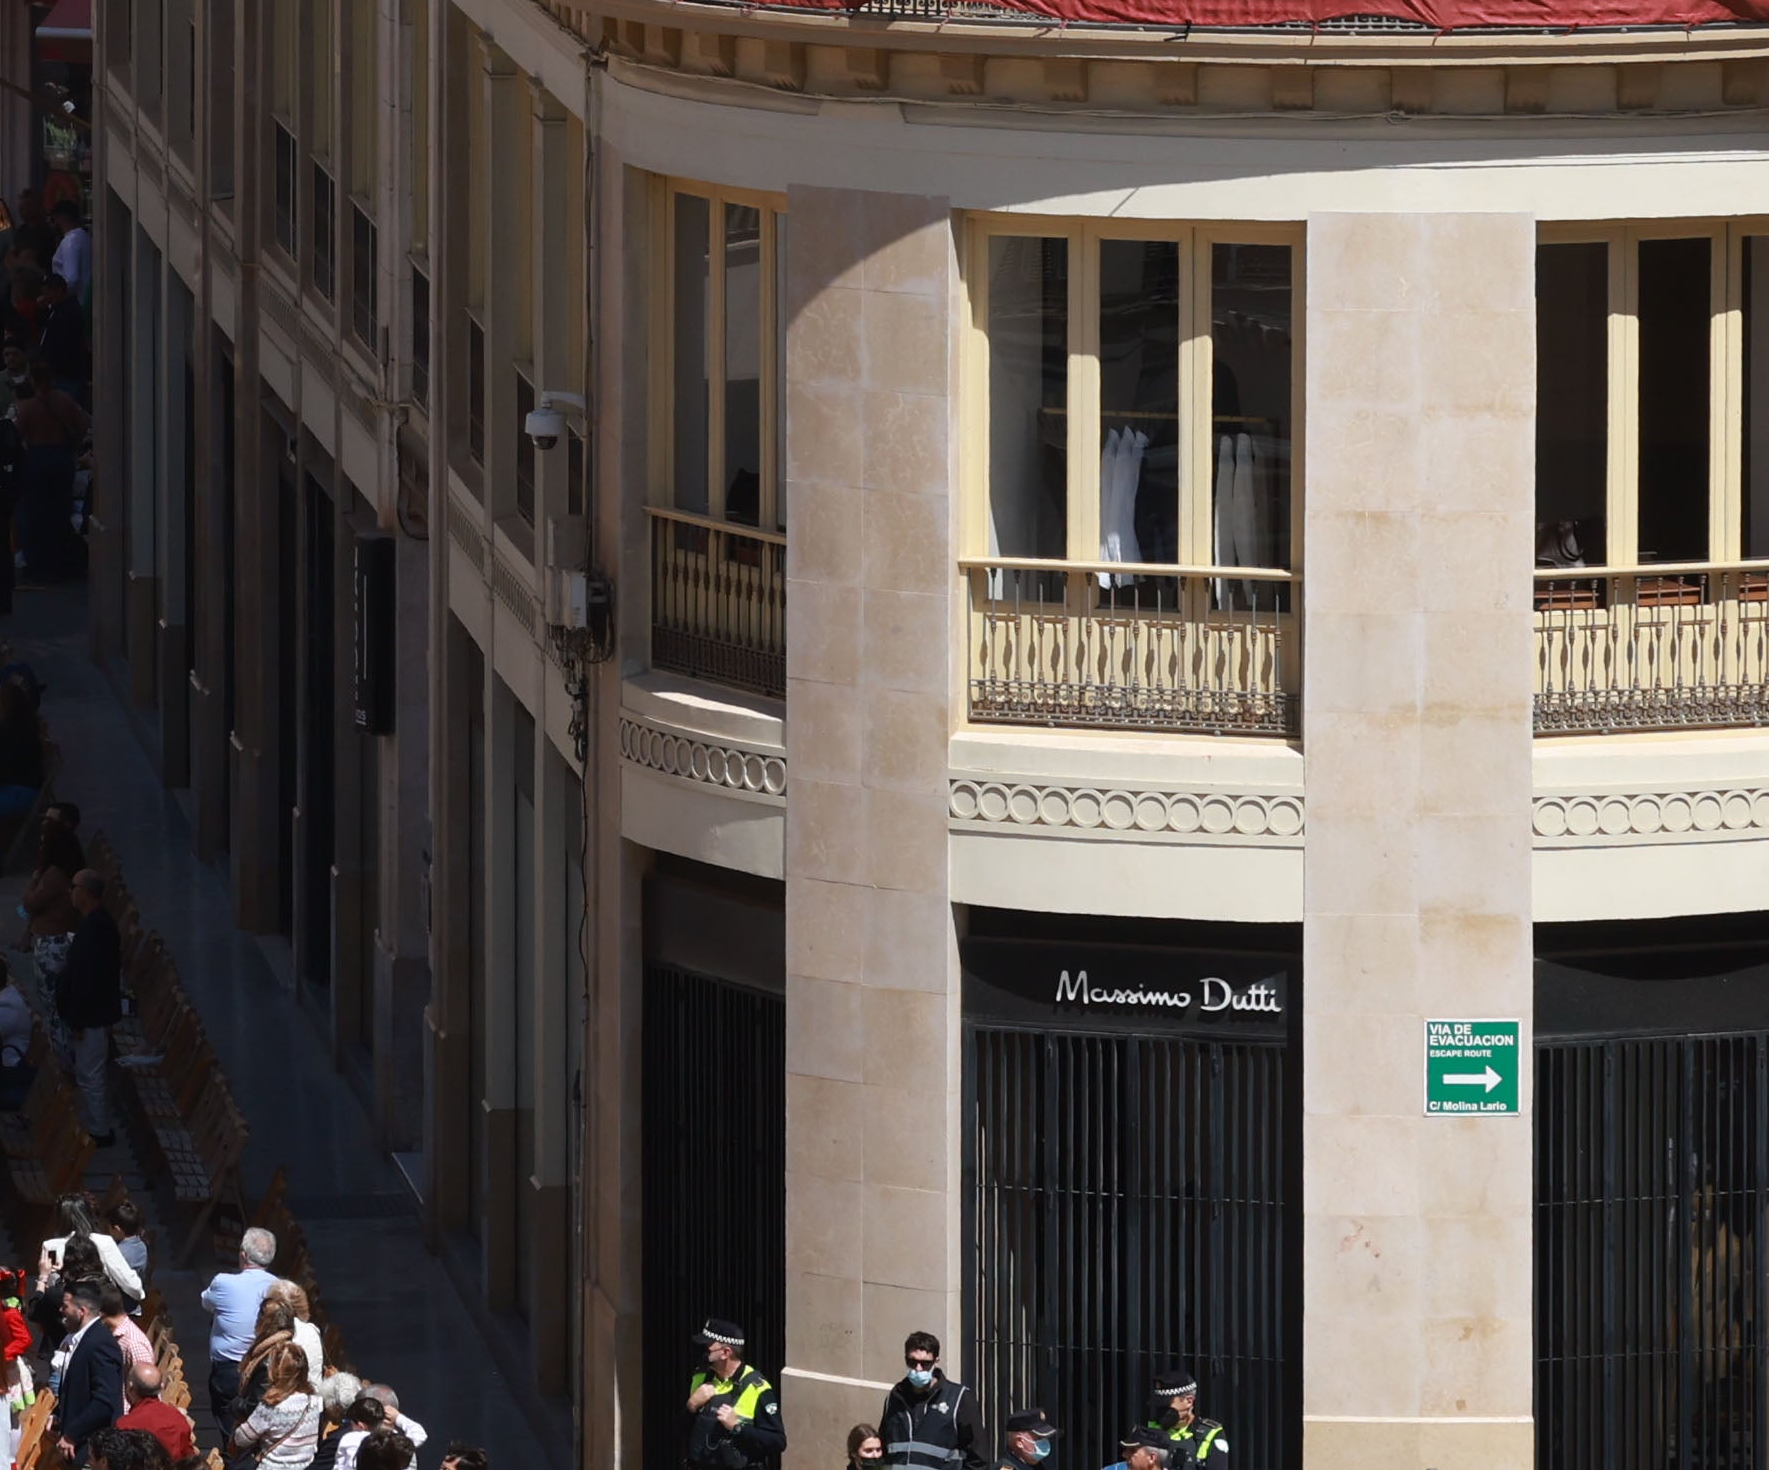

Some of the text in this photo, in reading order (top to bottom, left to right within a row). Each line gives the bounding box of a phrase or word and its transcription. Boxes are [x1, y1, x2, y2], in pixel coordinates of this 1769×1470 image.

[1056, 970, 1282, 1013] Massimo Dutti
[1429, 1024, 1472, 1035] VIA DE
[1429, 1035, 1514, 1046] EVACUACION
[1442, 1101, 1478, 1111] Molina
[1480, 1101, 1507, 1111] Lario
